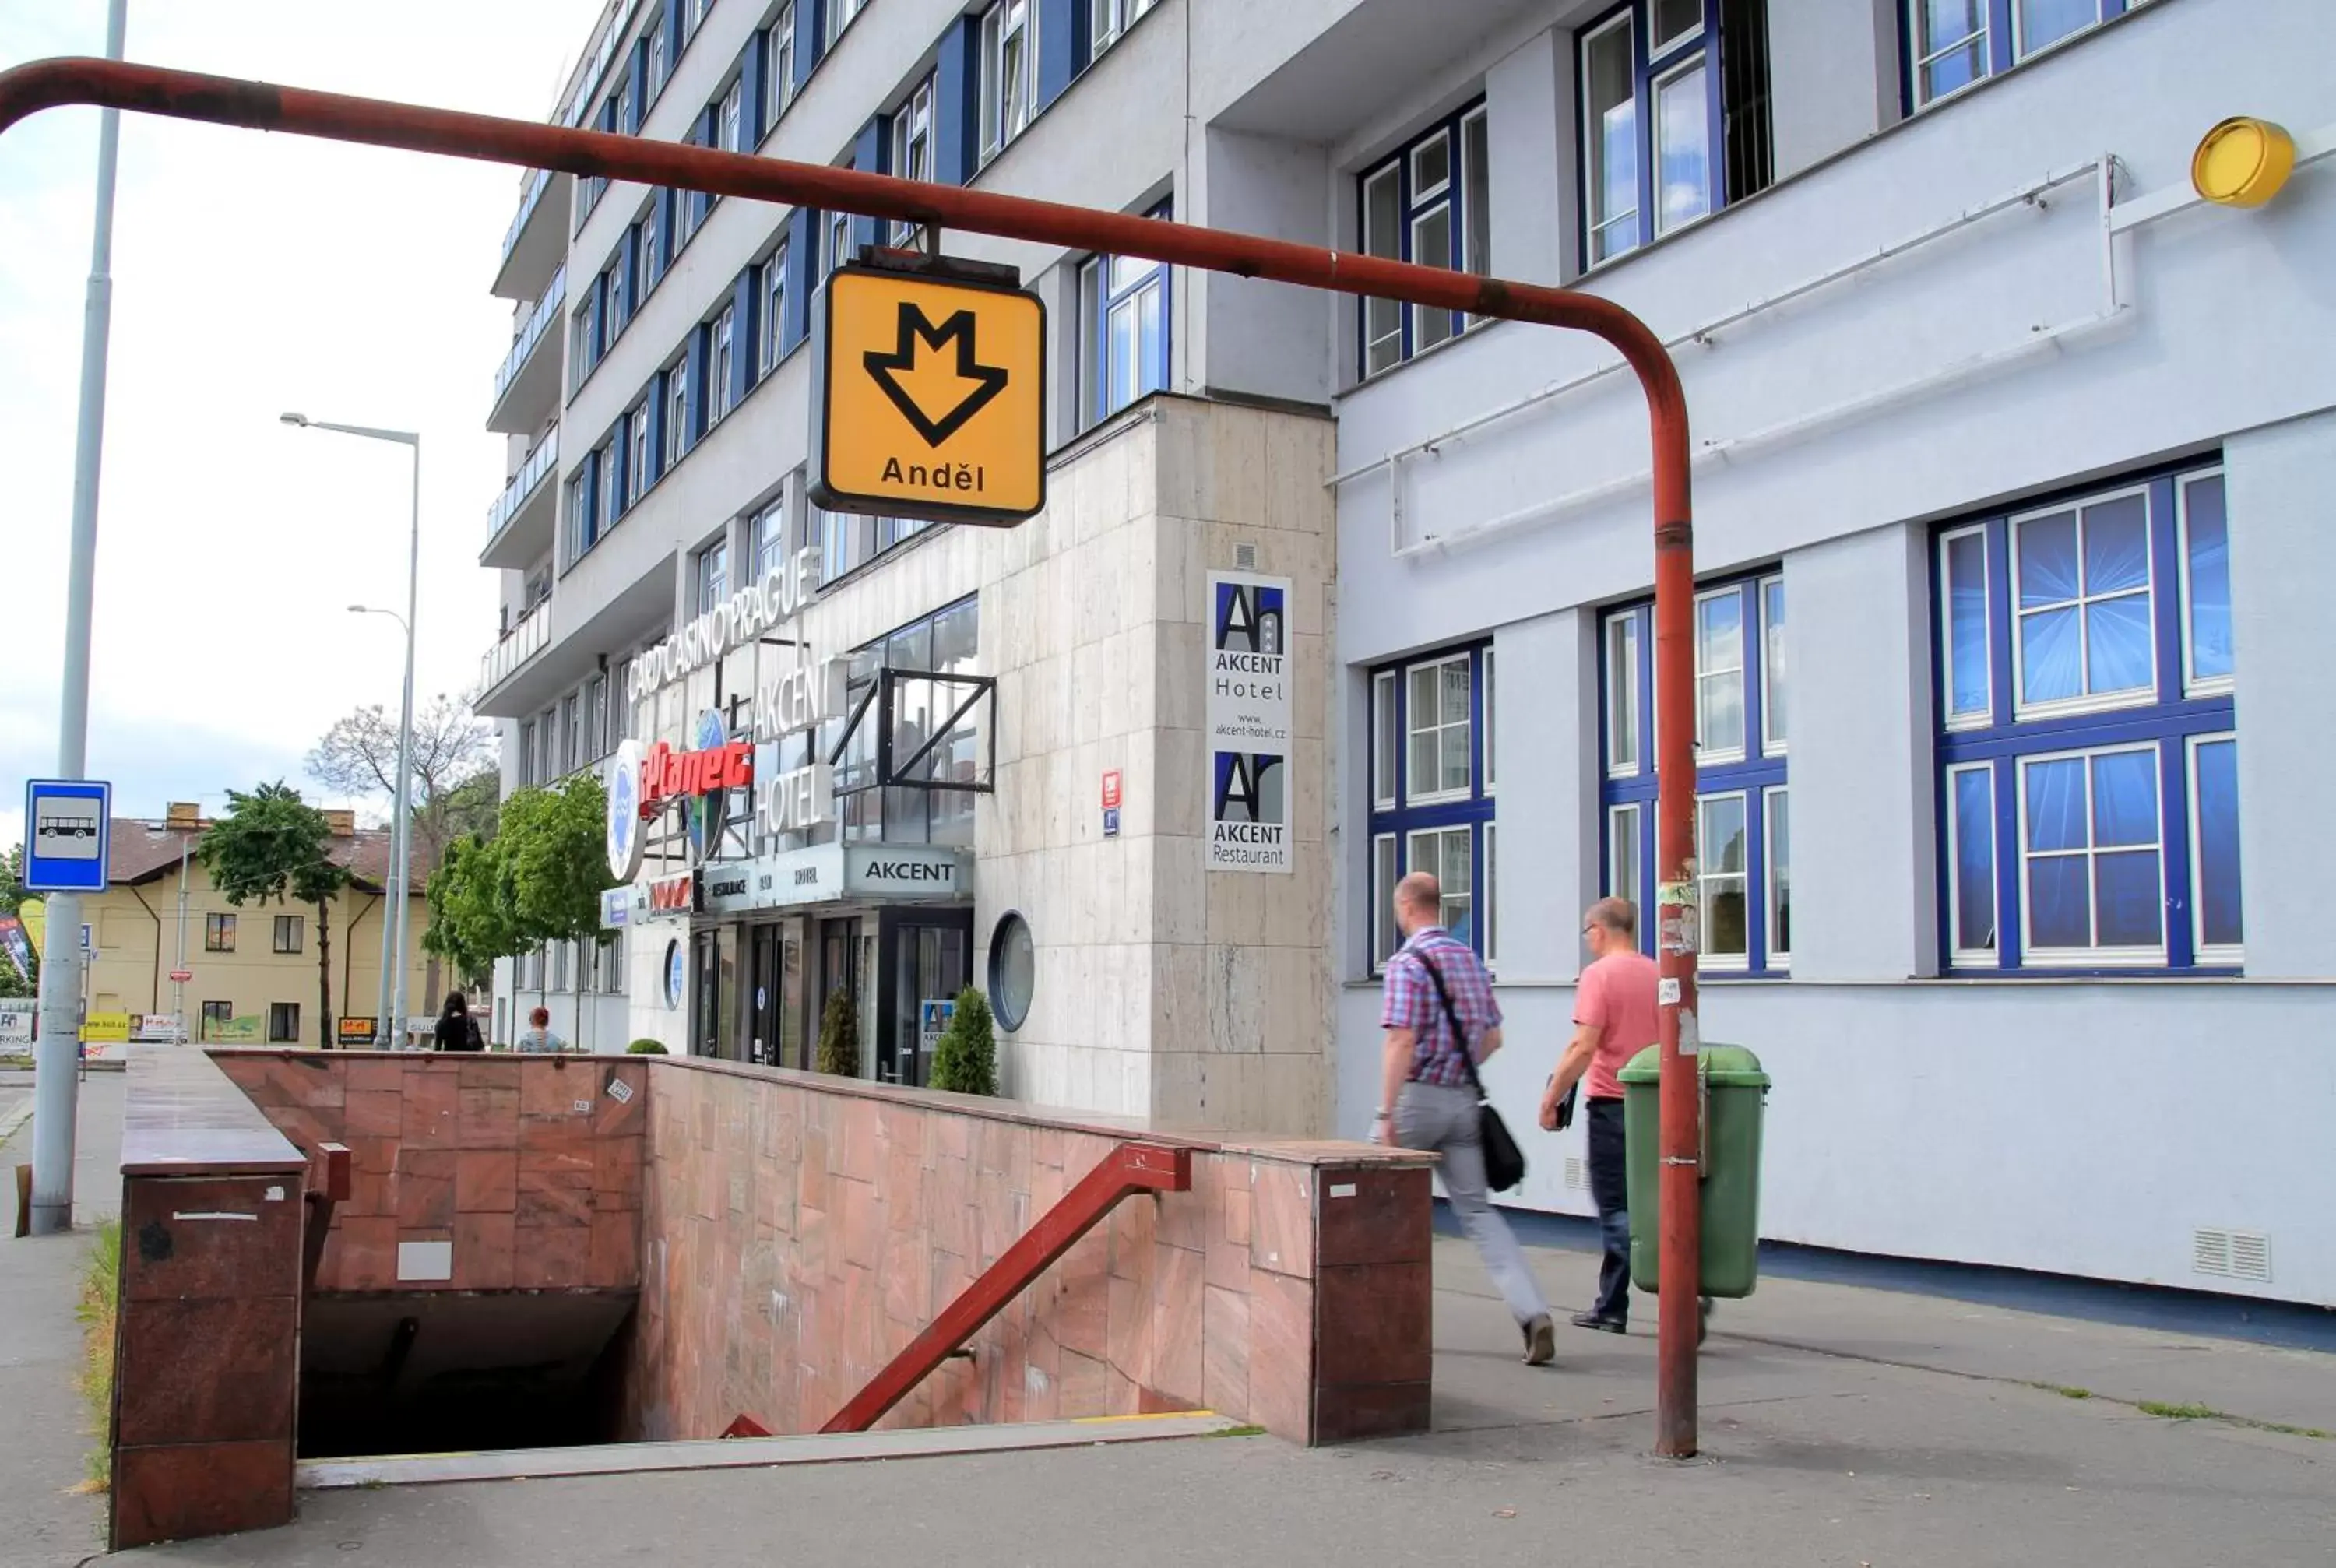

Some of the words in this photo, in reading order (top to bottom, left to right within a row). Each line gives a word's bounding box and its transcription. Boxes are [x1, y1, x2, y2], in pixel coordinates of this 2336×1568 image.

[881, 457, 984, 492] Anděl
[628, 645, 662, 702] CARD
[664, 604, 727, 682] CASINO
[730, 547, 814, 645] PRAGUE
[1215, 653, 1283, 674] AKCENT
[753, 655, 836, 744] AKCENT
[1215, 678, 1282, 701] Hotel
[1215, 724, 1287, 739] akcent-hotel.cz
[755, 764, 823, 837] HOTEL
[1214, 824, 1283, 844] AKCENT
[1213, 844, 1284, 865] Restaurant
[865, 860, 955, 881] AKCENT
